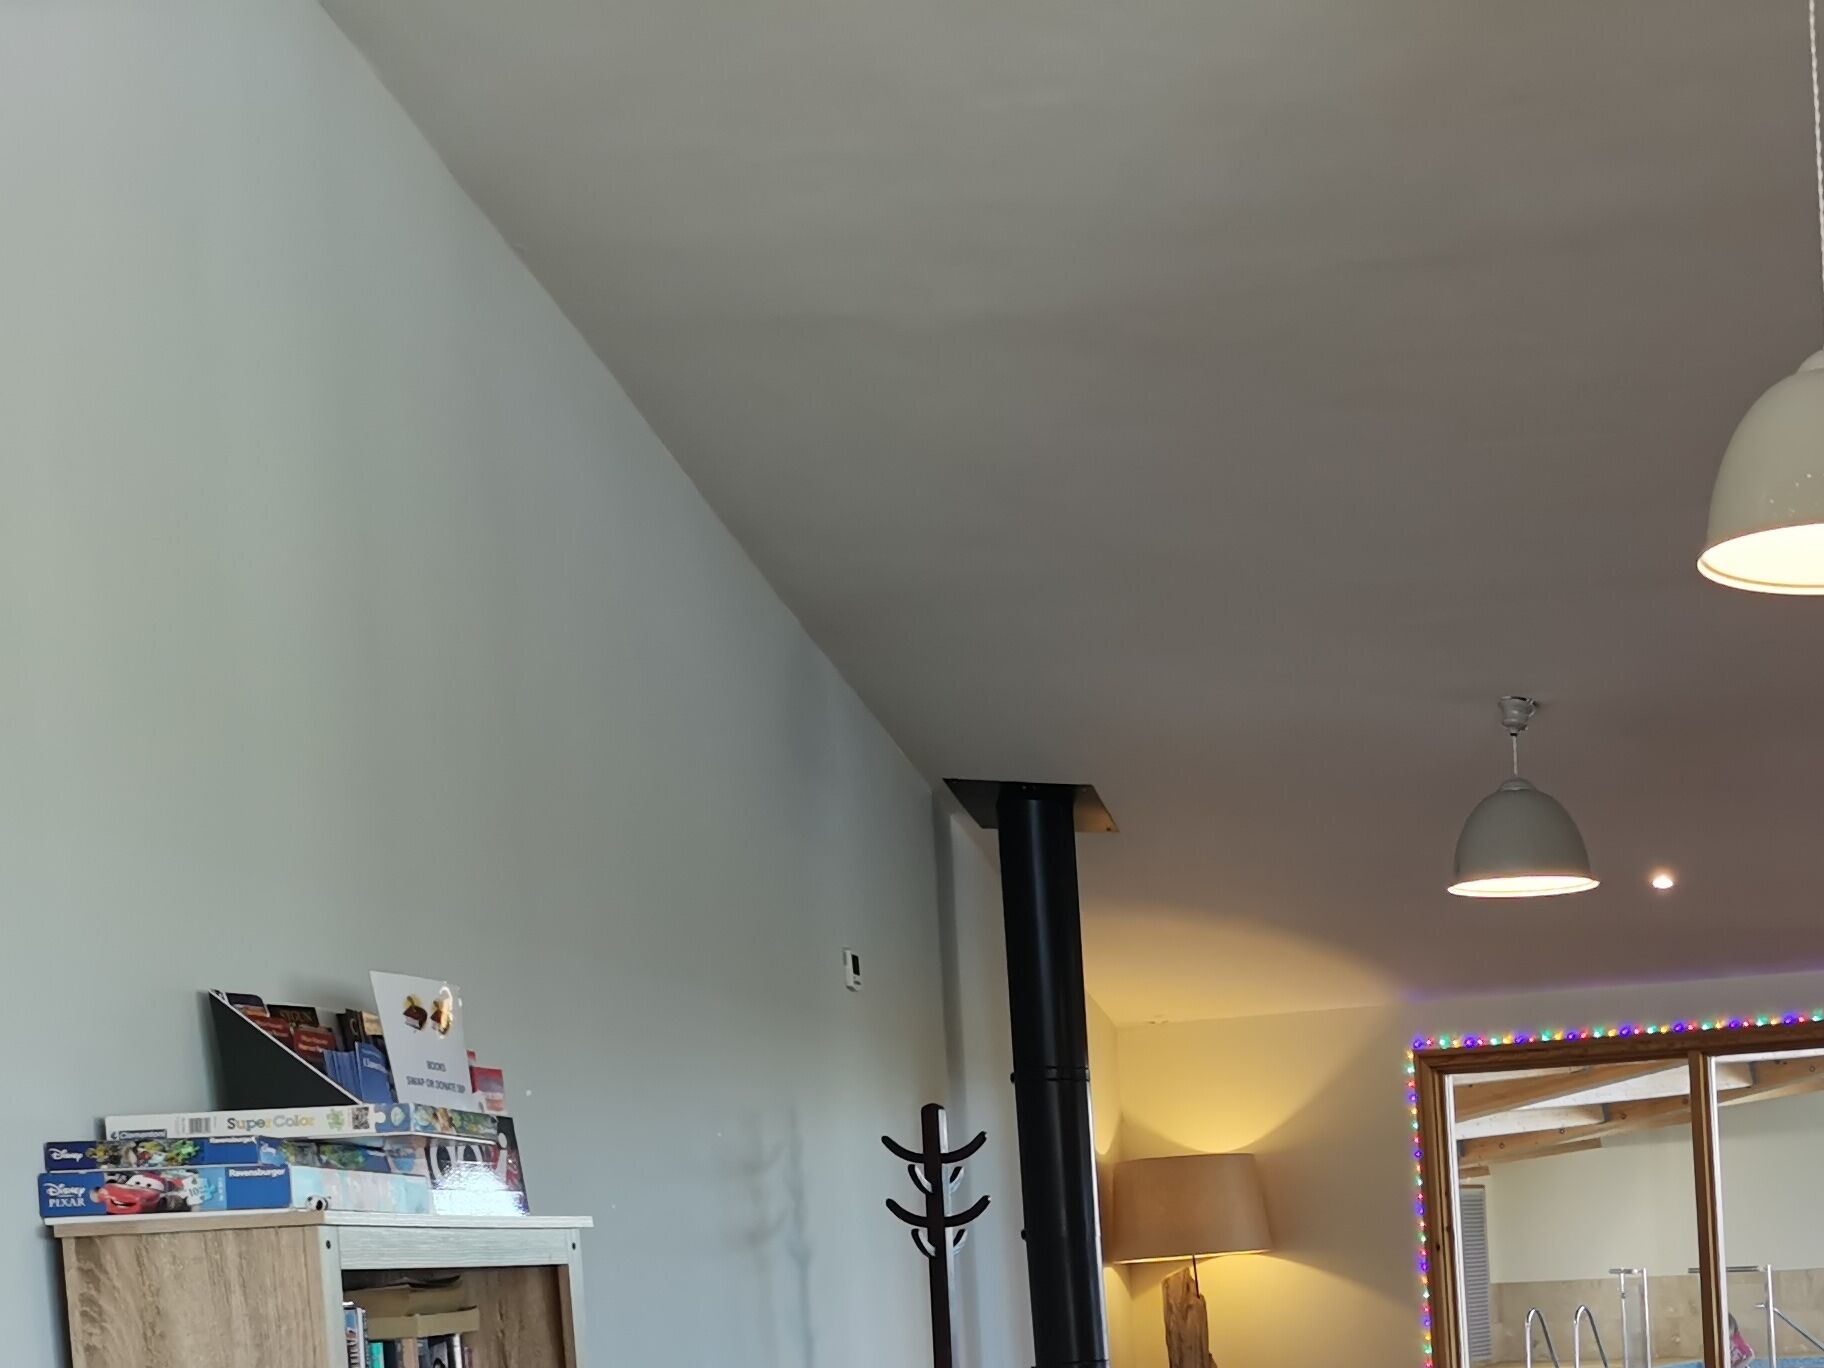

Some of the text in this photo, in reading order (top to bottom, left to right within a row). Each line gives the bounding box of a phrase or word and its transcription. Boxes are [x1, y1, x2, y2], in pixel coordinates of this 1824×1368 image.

[426, 1060, 447, 1072] BOOKS
[227, 1114, 315, 1131] SuperColor
[49, 1148, 84, 1162] Disney
[228, 1168, 285, 1178] Ravensburger
[44, 1183, 86, 1198] Disney
[49, 1198, 86, 1208] PIXAR
